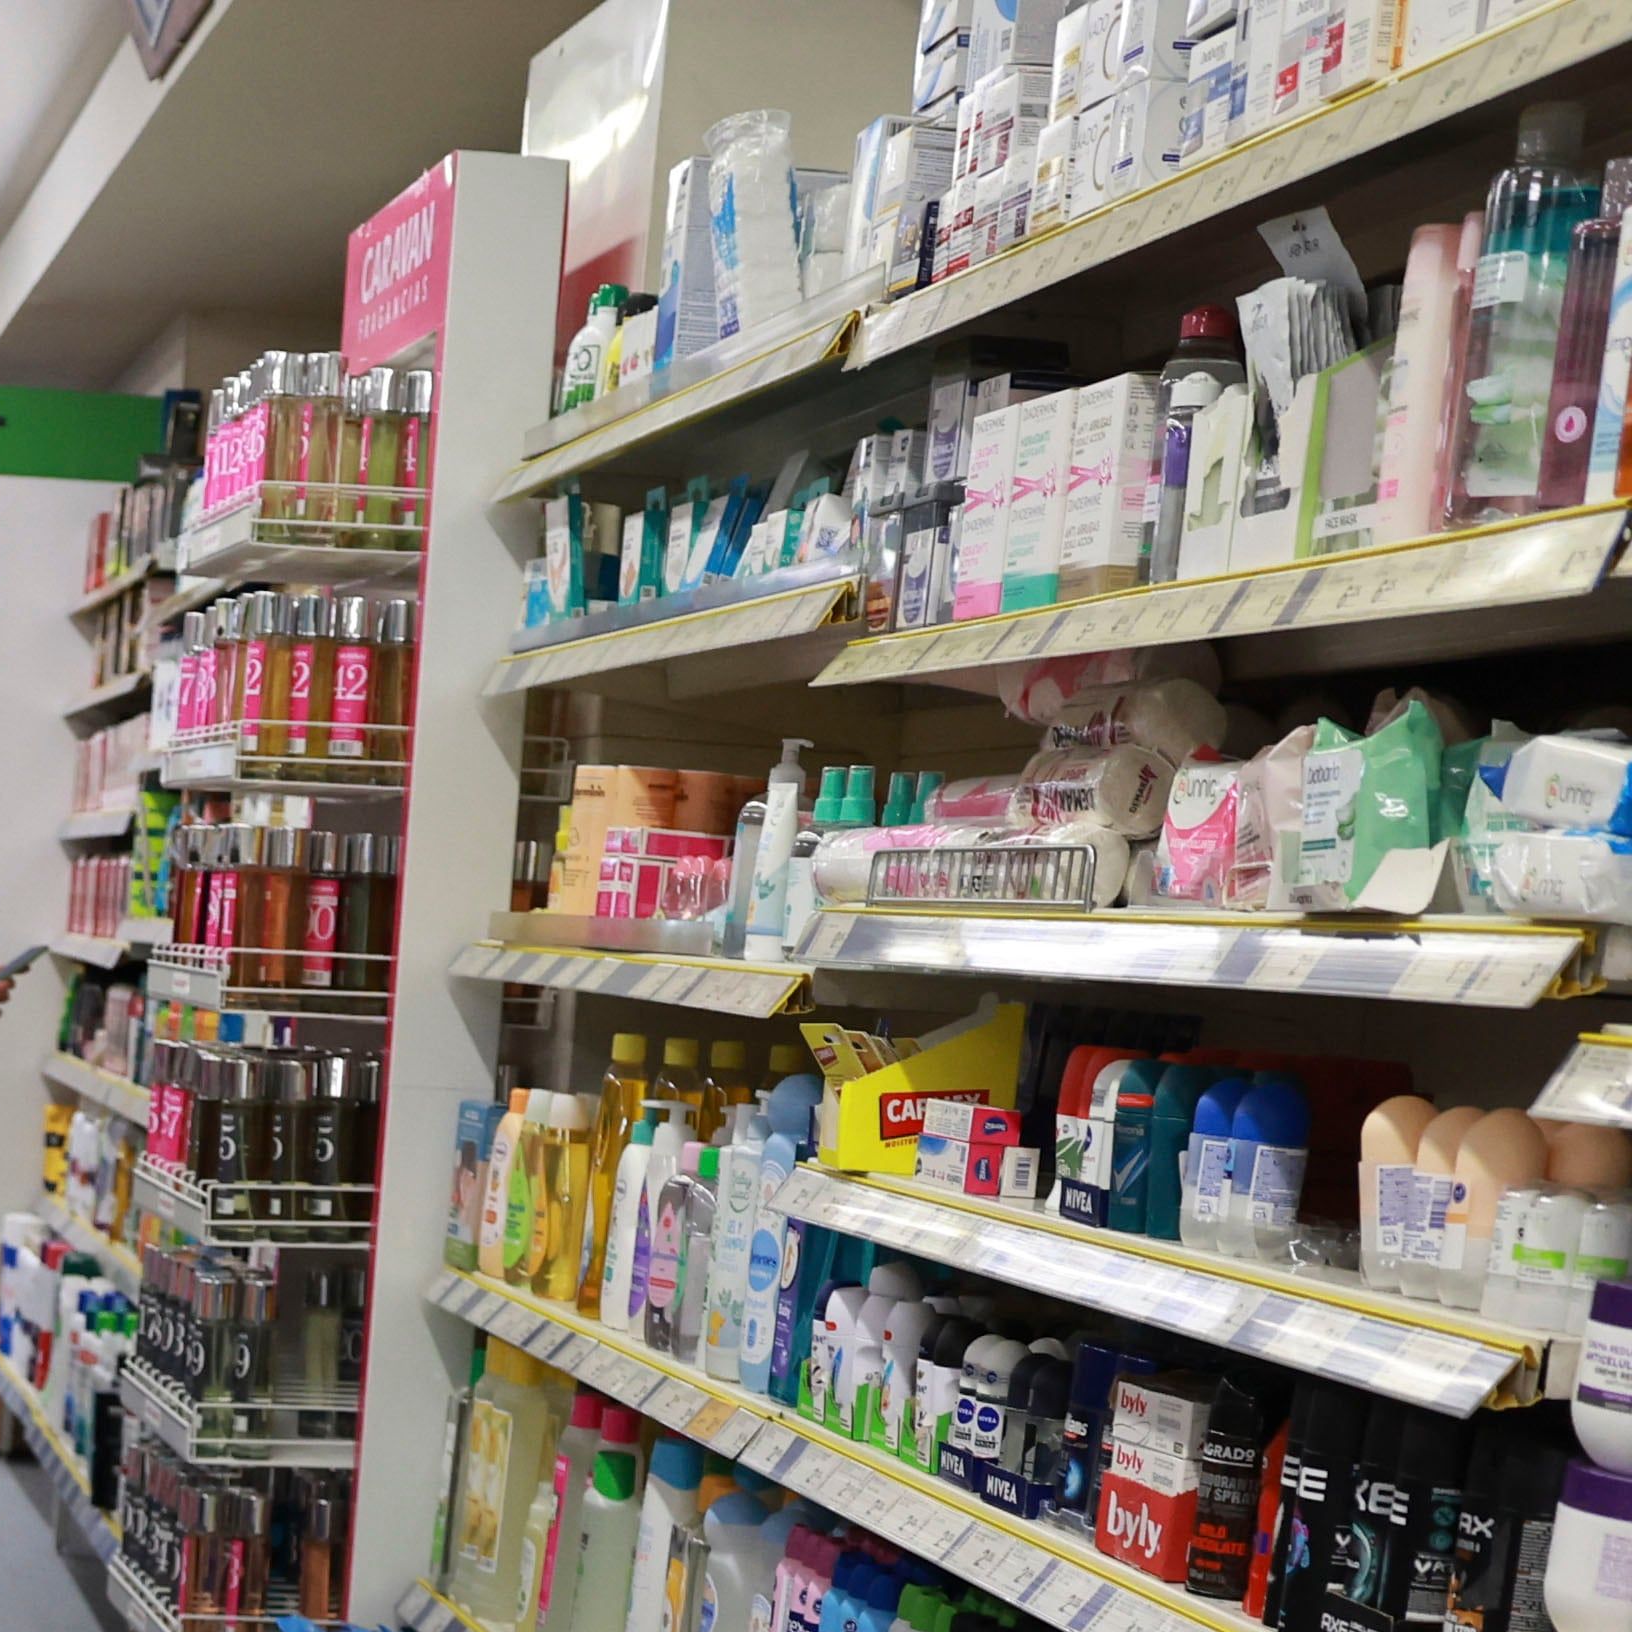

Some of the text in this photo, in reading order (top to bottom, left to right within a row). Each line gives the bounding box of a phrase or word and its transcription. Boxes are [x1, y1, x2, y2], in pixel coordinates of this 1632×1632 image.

[360, 201, 435, 304] CARAVAN
[358, 274, 429, 342] FRAGANCIAS
[1065, 1187, 1093, 1215] NIVEA
[1120, 1388, 1149, 1418] byly
[977, 1415, 998, 1426] NIVEA
[939, 1449, 966, 1479] NIVEA
[1116, 1448, 1145, 1473] byly
[986, 1473, 1018, 1505] NIVEA
[1106, 1491, 1162, 1560] byly
